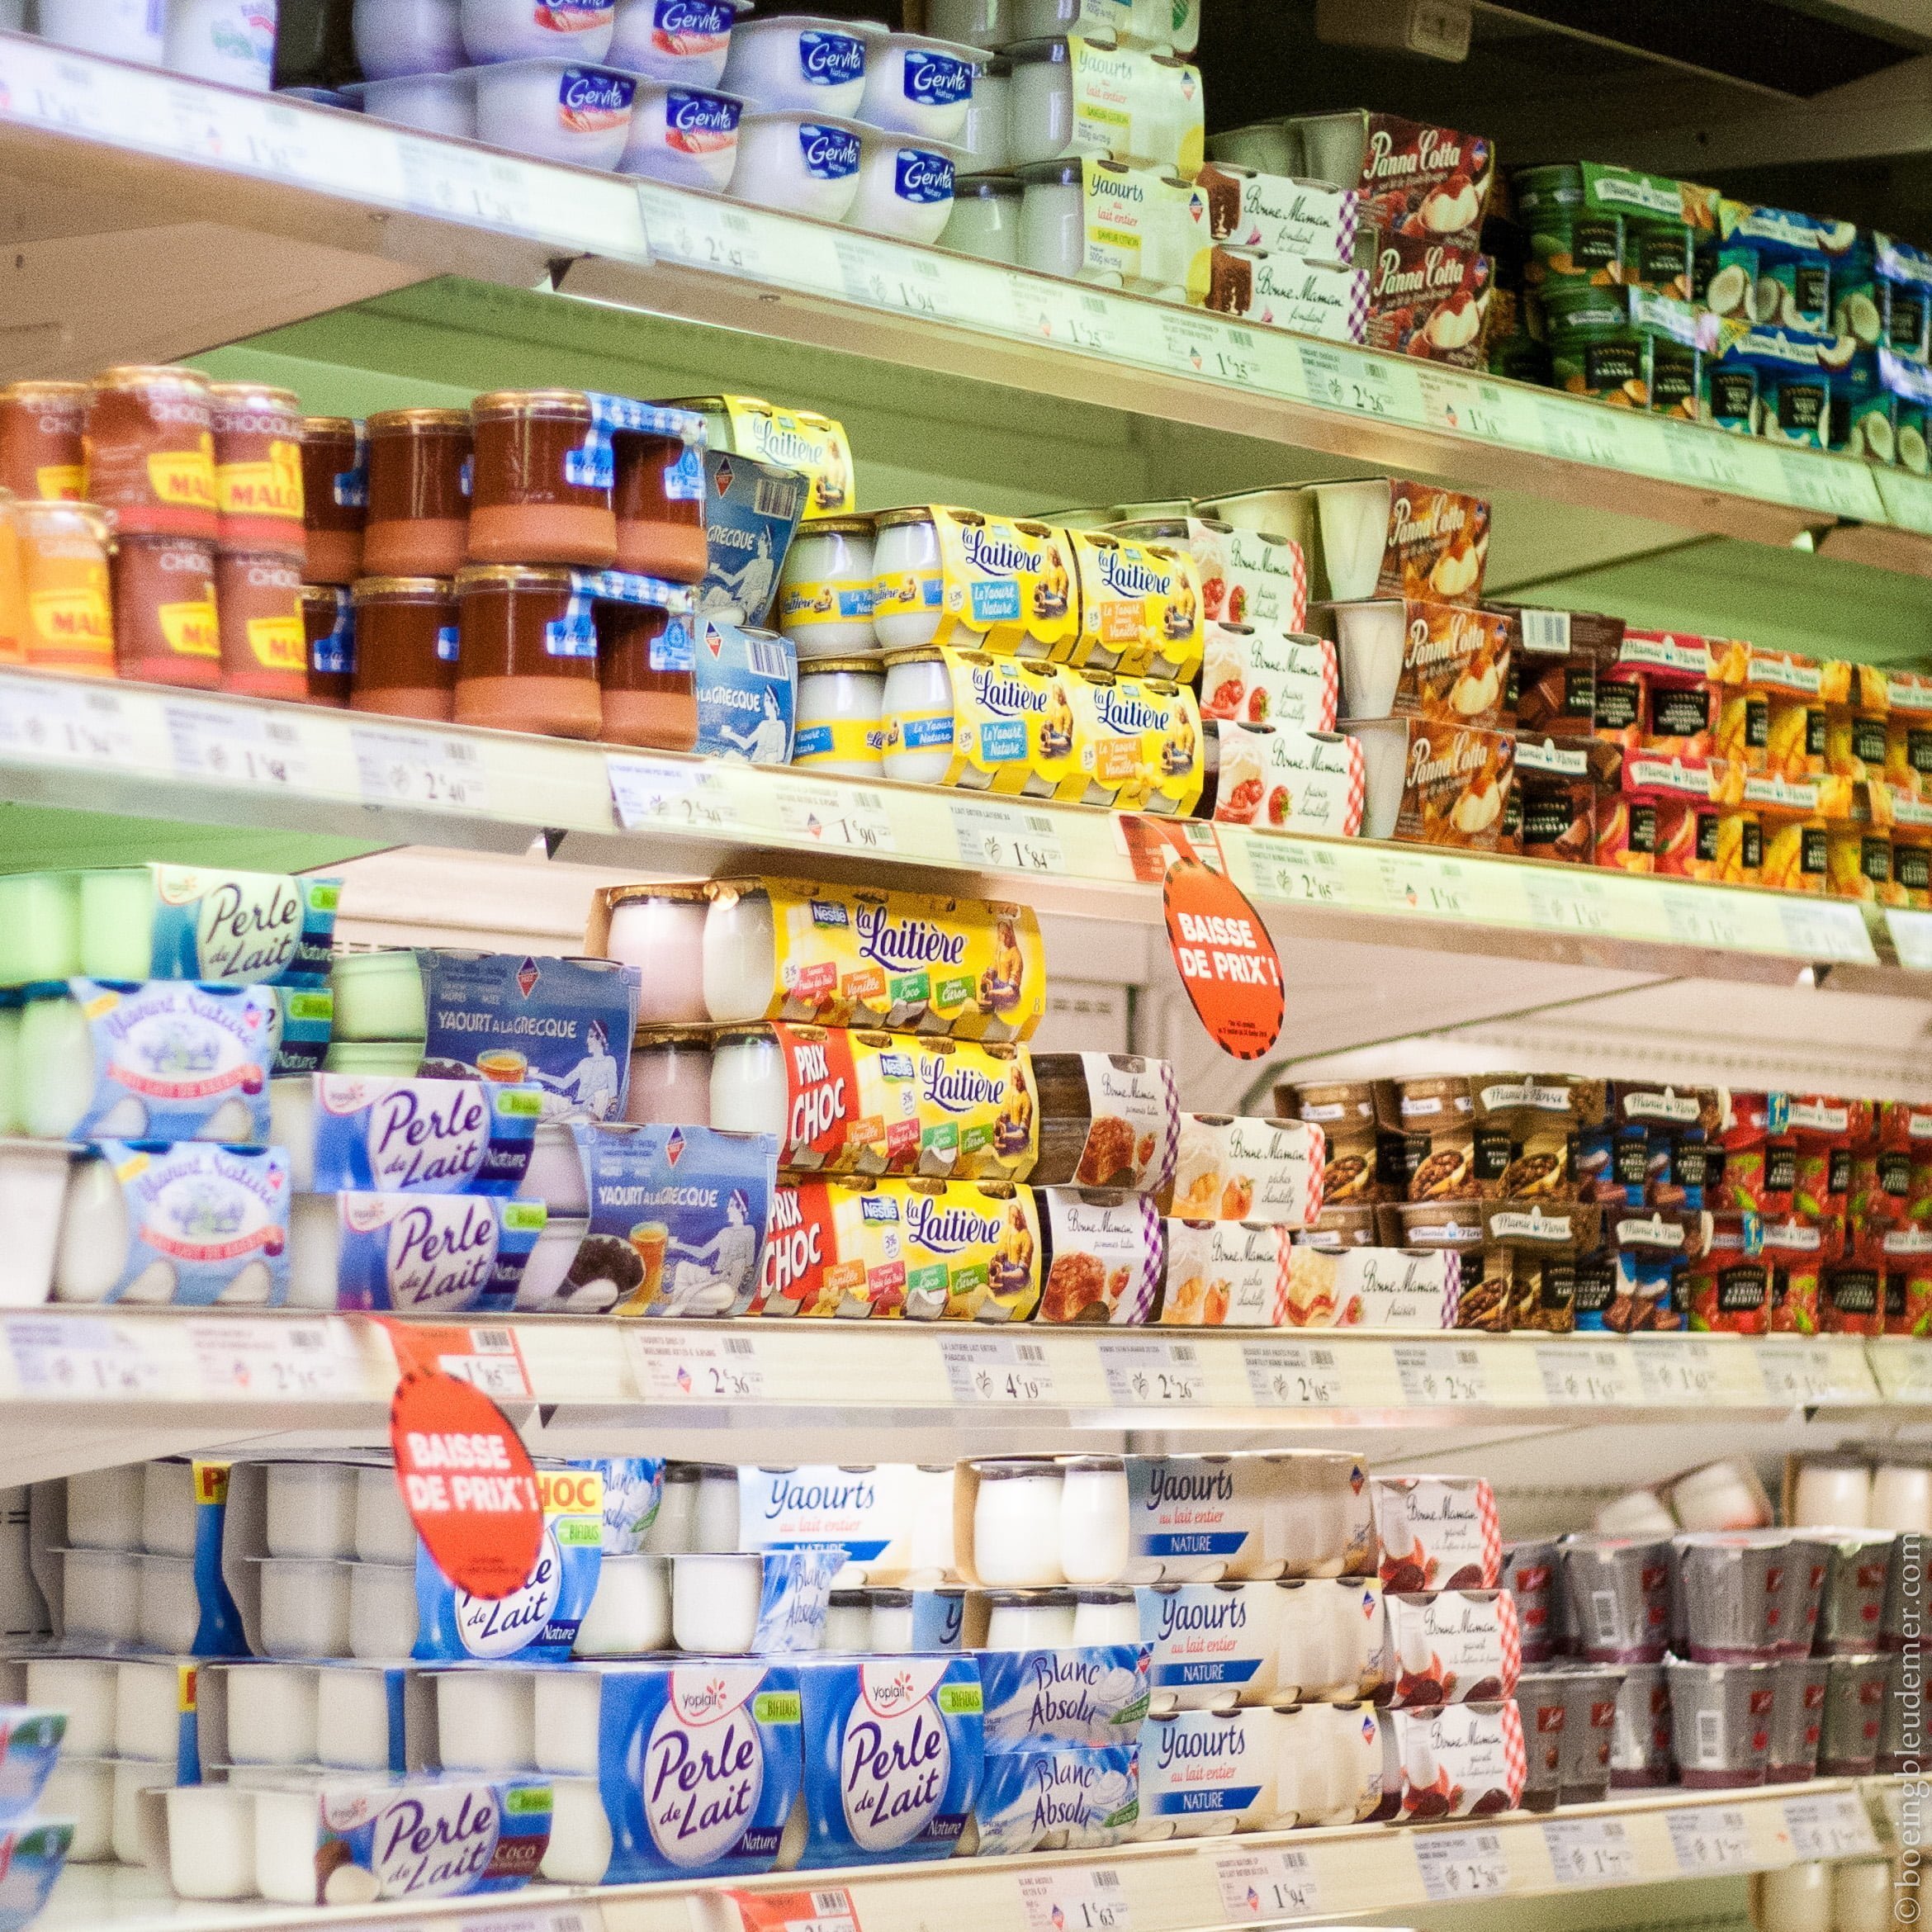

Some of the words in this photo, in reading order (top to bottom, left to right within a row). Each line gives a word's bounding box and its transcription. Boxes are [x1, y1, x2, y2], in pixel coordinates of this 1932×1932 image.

[662, 3, 721, 31] Gervita
[808, 43, 860, 70] Gervita
[914, 64, 965, 90] Gervita
[566, 79, 622, 108] Gervita
[676, 102, 732, 130] Gervita
[807, 136, 858, 164] Gervita
[1363, 130, 1418, 179] Panna
[1418, 130, 1461, 171] Cotta
[904, 162, 952, 188] Gervita
[1098, 206, 1112, 221] lait
[1115, 213, 1138, 227] entier
[1243, 184, 1281, 219] Bonne
[1283, 195, 1333, 228] Maman
[1256, 265, 1293, 299] Bonne
[1295, 275, 1343, 307] Maman
[1374, 248, 1424, 297] Panna
[1426, 246, 1465, 286] Cotta
[1388, 497, 1430, 547] Panna
[1429, 494, 1466, 535] Cotta
[708, 525, 756, 552] GRECQUE
[966, 530, 1041, 575] Laitière
[1231, 537, 1257, 571] Bonne
[1257, 542, 1291, 576] Maman
[1102, 553, 1170, 599] Laitière
[982, 600, 1012, 614] Nature
[1110, 625, 1139, 638] Vanille
[1405, 618, 1451, 670] Panna
[1450, 615, 1485, 653] Cotta
[1250, 638, 1281, 673] Bonne
[1280, 642, 1320, 678] Maman
[975, 670, 1048, 717] Laitière
[1097, 690, 1169, 735] Laitière
[991, 741, 1020, 755] Nature
[1271, 737, 1305, 771] Bonne
[1304, 740, 1346, 774] Maman
[1406, 736, 1451, 788] Panna
[1448, 734, 1488, 775] Cotta
[1106, 762, 1135, 776] Vanille
[207, 883, 297, 944] Perle
[813, 904, 846, 923] Nestlé
[855, 904, 871, 929] la
[859, 906, 966, 973] Laitière
[1178, 912, 1257, 949] BAISSE
[220, 934, 291, 978] Lait
[1179, 947, 1212, 979] DE
[847, 978, 879, 995] Vanille
[900, 987, 919, 999] Coco
[438, 1011, 493, 1032] YAOURT
[500, 1021, 513, 1033] LA
[515, 1016, 577, 1038] GRECQUE
[274, 1056, 316, 1069] Nature
[793, 1044, 829, 1086] PRIX
[882, 1058, 913, 1075] Nestlé
[921, 1057, 932, 1077] la
[924, 1057, 1004, 1113] Laitière
[1102, 1073, 1128, 1098] Bonne
[1129, 1077, 1157, 1101] Maman
[379, 1090, 482, 1154] Perle
[791, 1081, 846, 1145] CHOC
[485, 1152, 525, 1168] Nature
[1230, 1129, 1261, 1159] Bonne
[1261, 1131, 1307, 1161] Maman
[385, 1159, 405, 1174] de
[400, 1140, 477, 1188] Lait
[768, 1191, 803, 1233] PRIX
[864, 1202, 897, 1219] Nestlé
[907, 1198, 918, 1219] la
[1068, 1208, 1096, 1233] Bonne
[1096, 1210, 1133, 1234] Maman
[395, 1205, 492, 1269] Perle
[908, 1199, 1002, 1253] Laitière
[760, 1223, 822, 1299] CHOC
[1211, 1234, 1238, 1262] Bonne
[1238, 1235, 1275, 1262] Maman
[414, 1257, 486, 1304] Lait
[1361, 1260, 1397, 1294] Bonne
[1396, 1262, 1440, 1294] Maman
[406, 1432, 510, 1470] BAISSE
[406, 1475, 450, 1510] DE
[765, 1480, 874, 1519] Yaourts
[1146, 1468, 1233, 1511] Yaourts
[1174, 1508, 1193, 1524] lait
[1195, 1508, 1225, 1523] entier
[1407, 1494, 1437, 1521] Bonne
[1437, 1495, 1478, 1522] Maman
[570, 1524, 599, 1539] BIFIDUS
[780, 1519, 797, 1532] au
[798, 1517, 822, 1532] lait
[824, 1518, 860, 1533] entier
[1171, 1536, 1211, 1552] NATURE
[467, 1612, 486, 1627] de
[481, 1595, 547, 1639] Lait
[542, 1625, 575, 1640] Nature
[1158, 1598, 1246, 1641] Yaourts
[1424, 1608, 1455, 1636] Bonne
[1455, 1609, 1497, 1634] Maman
[1172, 1644, 1184, 1655] au
[1186, 1637, 1205, 1653] lait
[1206, 1636, 1238, 1651] entier
[1033, 1654, 1101, 1691] Blanc
[1183, 1664, 1224, 1682] NATURE
[683, 1693, 717, 1708] Yoplait
[874, 1684, 905, 1699] Yoplait
[951, 1690, 980, 1707] BIFIDUS
[768, 1699, 798, 1717] BIFIDUS
[1028, 1689, 1096, 1732] Absolu
[1158, 1725, 1245, 1769] Yaourts
[1430, 1721, 1462, 1750] Bonne
[1461, 1721, 1503, 1746] Maman
[651, 1724, 754, 1802] Perle
[847, 1715, 941, 1792] Perle
[1035, 1757, 1095, 1793] Blanc
[1171, 1773, 1183, 1783] au
[1186, 1765, 1205, 1782] lait
[1206, 1764, 1238, 1780] entier
[661, 1802, 681, 1825] de
[677, 1779, 751, 1840] Lait
[855, 1788, 874, 1813] de
[870, 1767, 938, 1827] Lait
[1032, 1792, 1091, 1833] Absolu
[1182, 1792, 1224, 1810] NATURE
[381, 1792, 491, 1866] Perle
[742, 1834, 778, 1850] Nature
[928, 1819, 960, 1835] Nature
[388, 1864, 410, 1882] de
[404, 1841, 485, 1894] Lait
